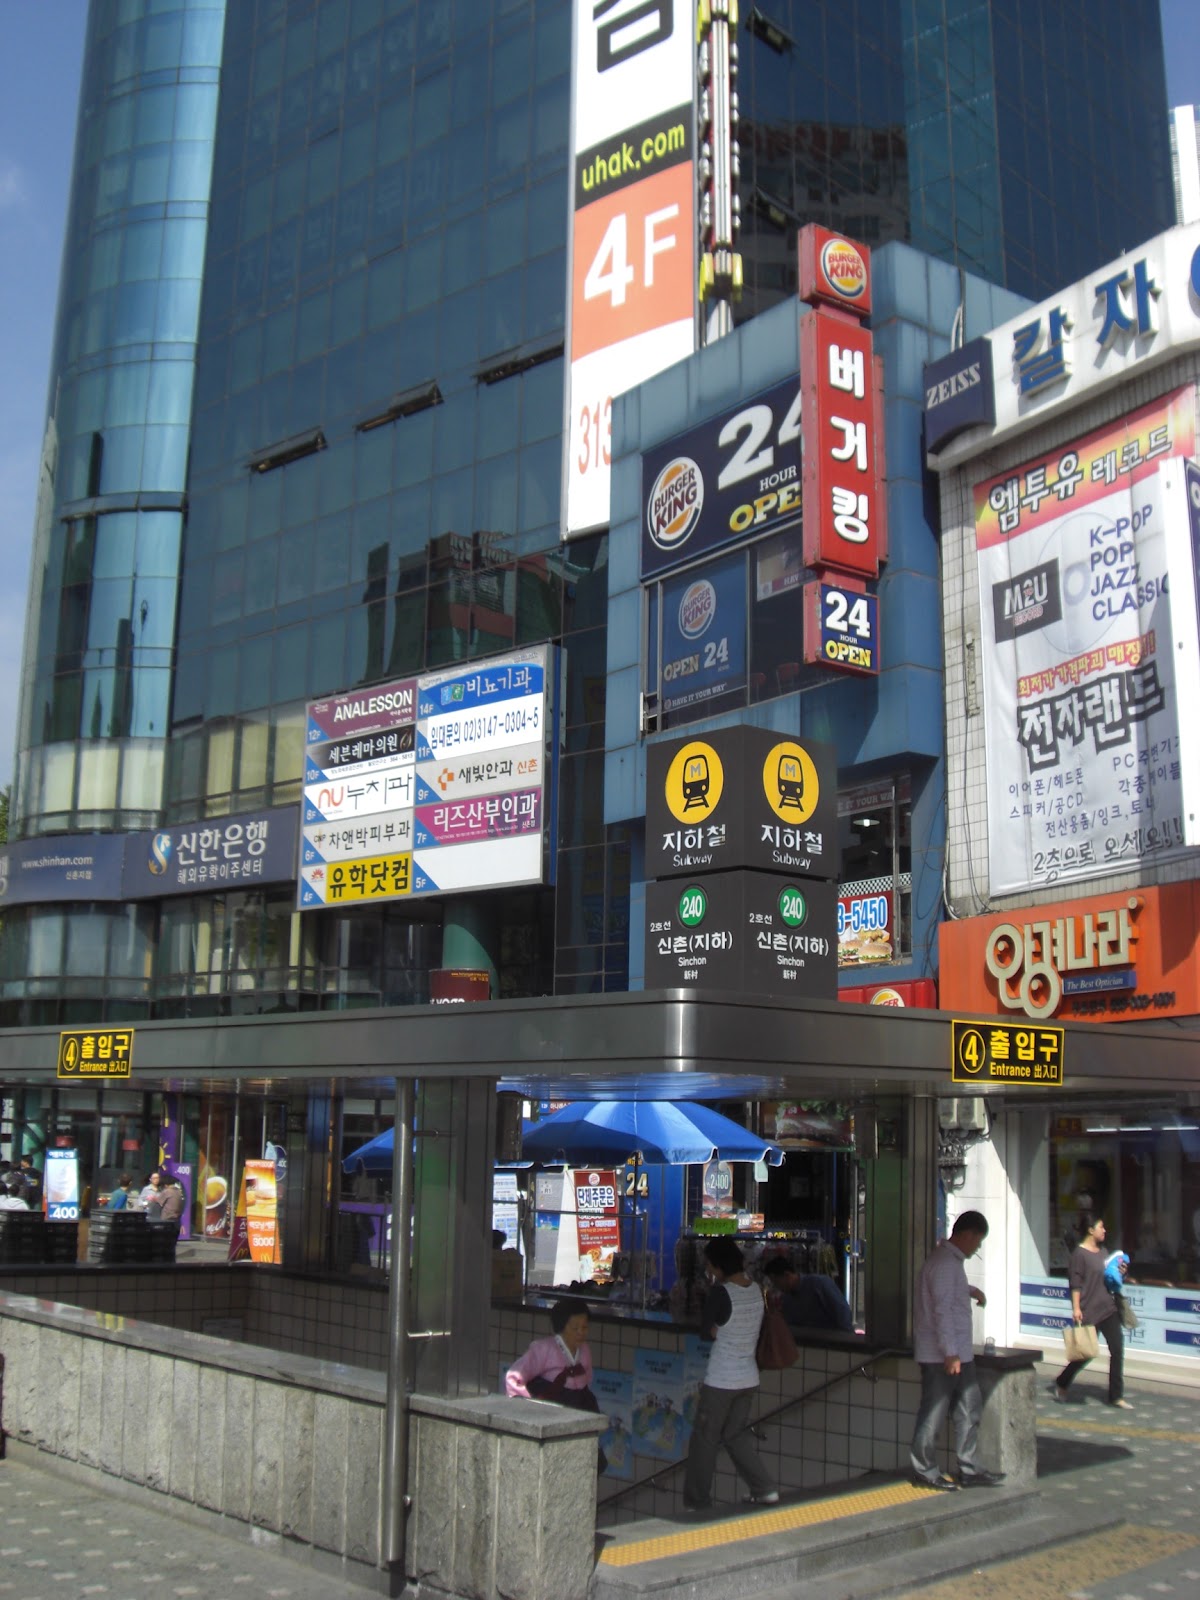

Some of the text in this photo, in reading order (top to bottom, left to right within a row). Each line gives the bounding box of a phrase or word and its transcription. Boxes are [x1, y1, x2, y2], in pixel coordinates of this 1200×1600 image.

[581, 123, 686, 191] uhak.com
[828, 252, 862, 266] BURGER
[828, 263, 863, 281] KING
[926, 362, 981, 409] ZEISS
[829, 343, 869, 544] 버거킹
[759, 465, 797, 491] HOUR
[989, 425, 1173, 534] 엠투유 레코드
[653, 466, 696, 517] BURGER
[655, 485, 698, 539] KING
[1090, 503, 1153, 547] K-POP
[1090, 541, 1135, 572] POP
[1091, 562, 1142, 597] JAZZ
[683, 587, 711, 614] BURGER
[683, 597, 712, 628] KING
[826, 591, 870, 637] 24
[840, 634, 857, 644] HOUR
[664, 637, 729, 681] OPEN 24
[826, 640, 871, 667] OPEN
[466, 666, 532, 697] 비뇨기과
[333, 689, 413, 722] ANALESSON
[419, 704, 434, 715] 14F
[672, 696, 688, 706] HAVE
[1018, 661, 1164, 773] 전자랜드
[309, 728, 321, 740] 12F
[431, 722, 461, 749] 임대문의
[329, 733, 398, 764] 세븐레마의원
[418, 746, 430, 758] 11F
[307, 770, 319, 781] 10F
[458, 758, 538, 784] 새빛안과 신촌
[346, 773, 413, 810] 누치과
[418, 789, 429, 801] 9F
[306, 809, 316, 820] 8F
[434, 793, 538, 833] 리즈산부인과
[176, 820, 268, 864] 신한은행
[328, 820, 411, 851] 차앤박피부과
[416, 832, 427, 844] 7F
[662, 823, 726, 852] 지하철
[761, 824, 823, 855] 지하철
[22, 856, 92, 868] www.shinhan.com
[305, 851, 314, 861] 6F
[772, 850, 811, 870] Subway
[1034, 840, 1096, 885] 2층으로
[177, 859, 262, 884] 해외유학이주센터
[329, 857, 409, 898] 유학닷컴
[416, 877, 427, 889] 5F
[303, 892, 313, 903] 4F
[682, 895, 702, 919] 240
[782, 895, 803, 918] 240
[650, 920, 672, 933] 2호선
[749, 912, 773, 926] 2호선
[657, 931, 734, 956] 신촌(지하)
[756, 931, 829, 957] 신촌(지하)
[678, 955, 707, 967] Sinchon
[776, 954, 805, 968] Sinchon
[683, 969, 699, 980] 新村
[782, 969, 798, 980] 新村
[1067, 976, 1124, 991] The Best Optician
[81, 1035, 128, 1058] 출입구
[990, 1030, 1059, 1062] 출입구
[79, 1061, 127, 1073] Entrance 出入口
[990, 1062, 1058, 1079] Entrance 出入口
[53, 1207, 78, 1219] 400
[1042, 1288, 1065, 1298] ACUVUE
[1042, 1318, 1065, 1328] ACUVUE
